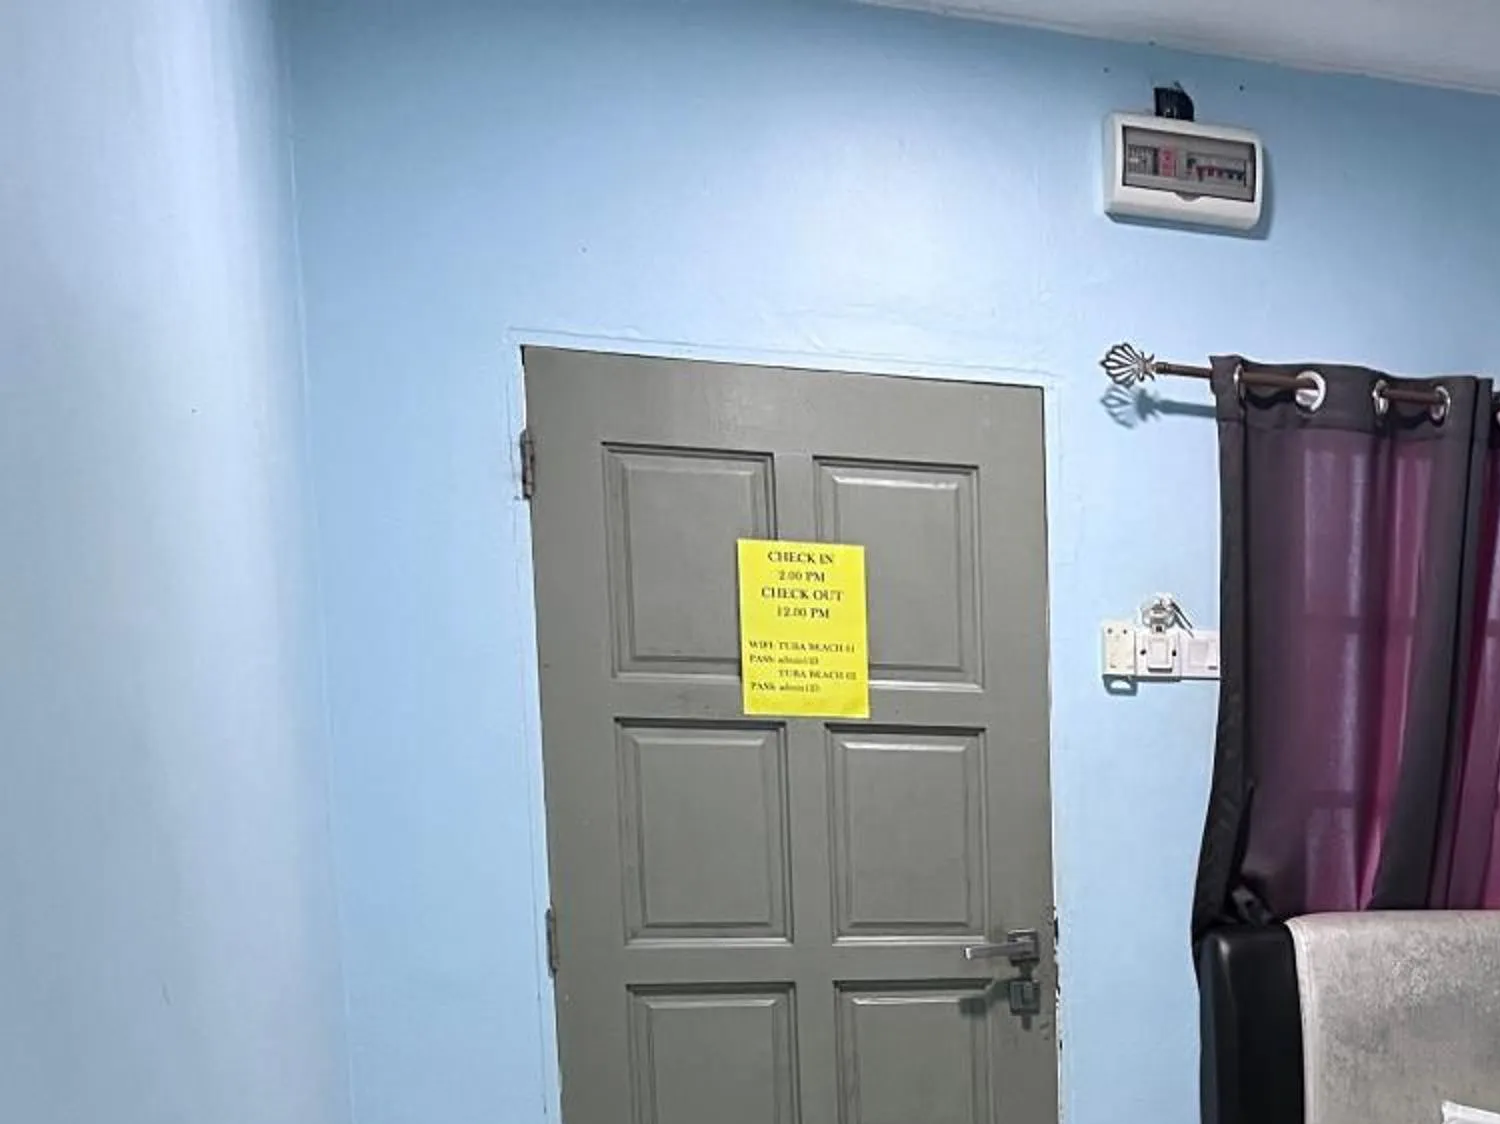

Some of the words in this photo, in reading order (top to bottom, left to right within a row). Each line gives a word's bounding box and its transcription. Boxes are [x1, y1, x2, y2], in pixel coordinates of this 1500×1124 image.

[768, 551, 816, 564] CHECK
[819, 553, 833, 564] IN
[805, 571, 825, 582] PM
[761, 587, 809, 599] CHECK
[813, 589, 844, 601] OUT
[810, 607, 830, 618] PM
